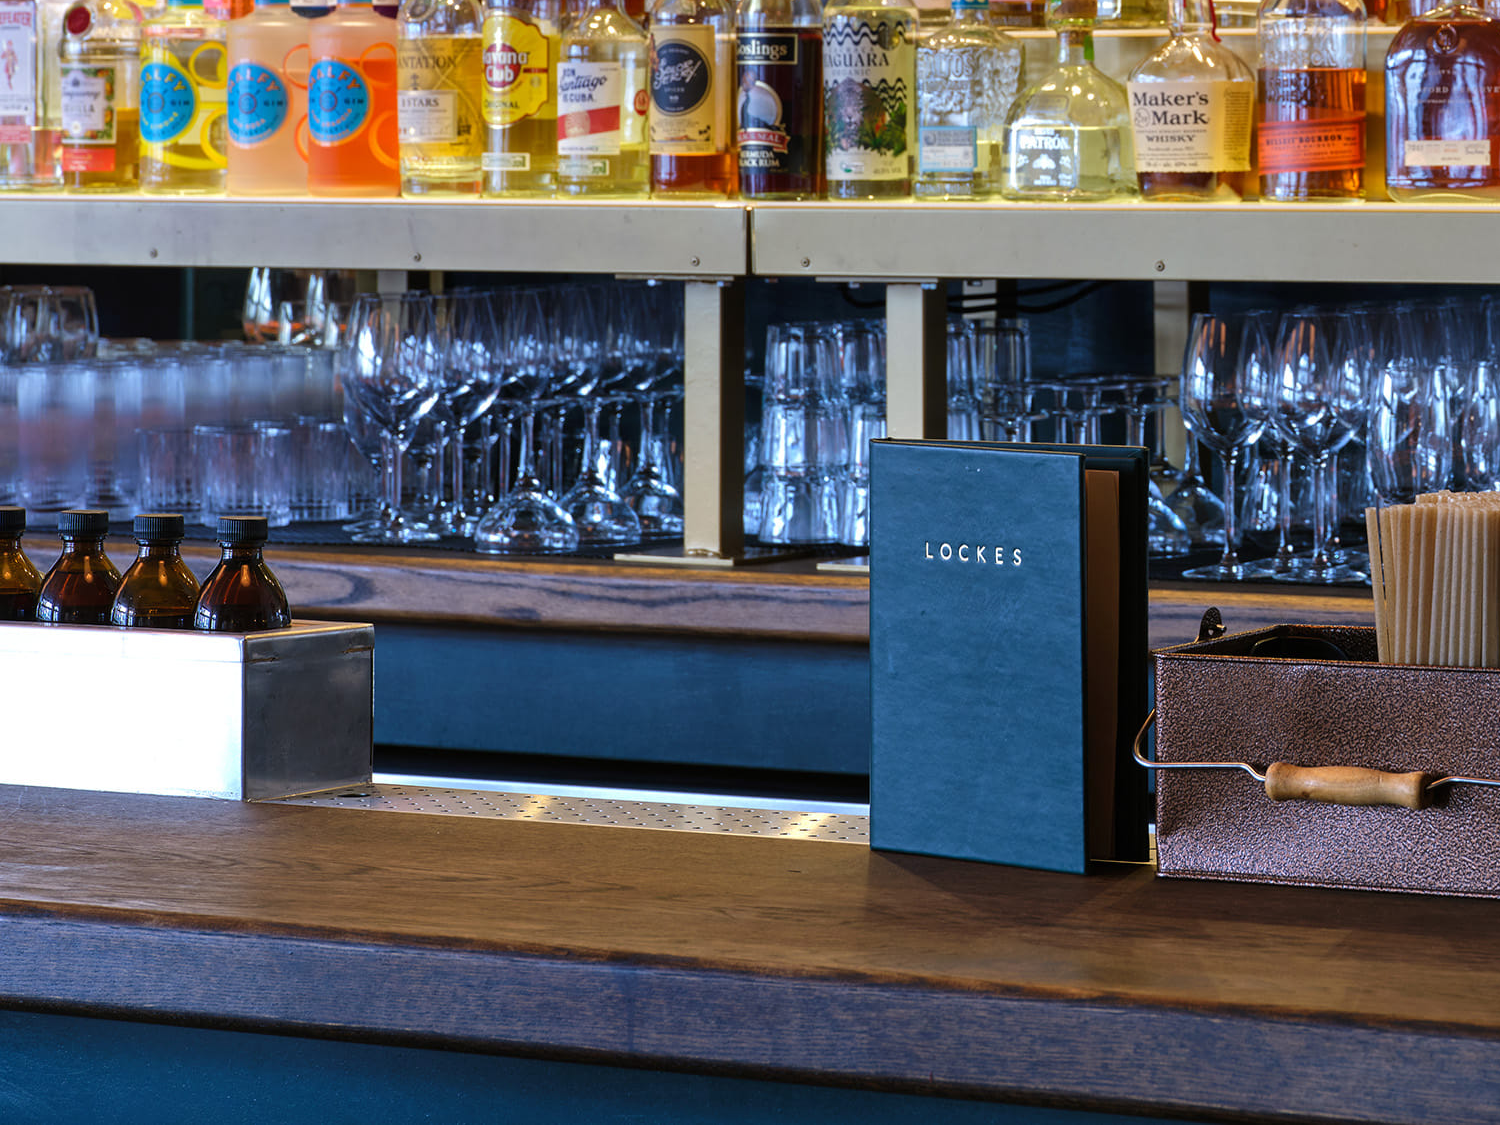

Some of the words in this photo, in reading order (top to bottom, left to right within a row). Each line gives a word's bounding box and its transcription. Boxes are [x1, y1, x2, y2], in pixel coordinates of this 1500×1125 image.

[485, 65, 515, 82] Club
[1133, 90, 1210, 107] Maker's
[1151, 109, 1208, 126] Mark
[1145, 134, 1196, 143] WHISKY
[924, 541, 1024, 567] LOCKES
